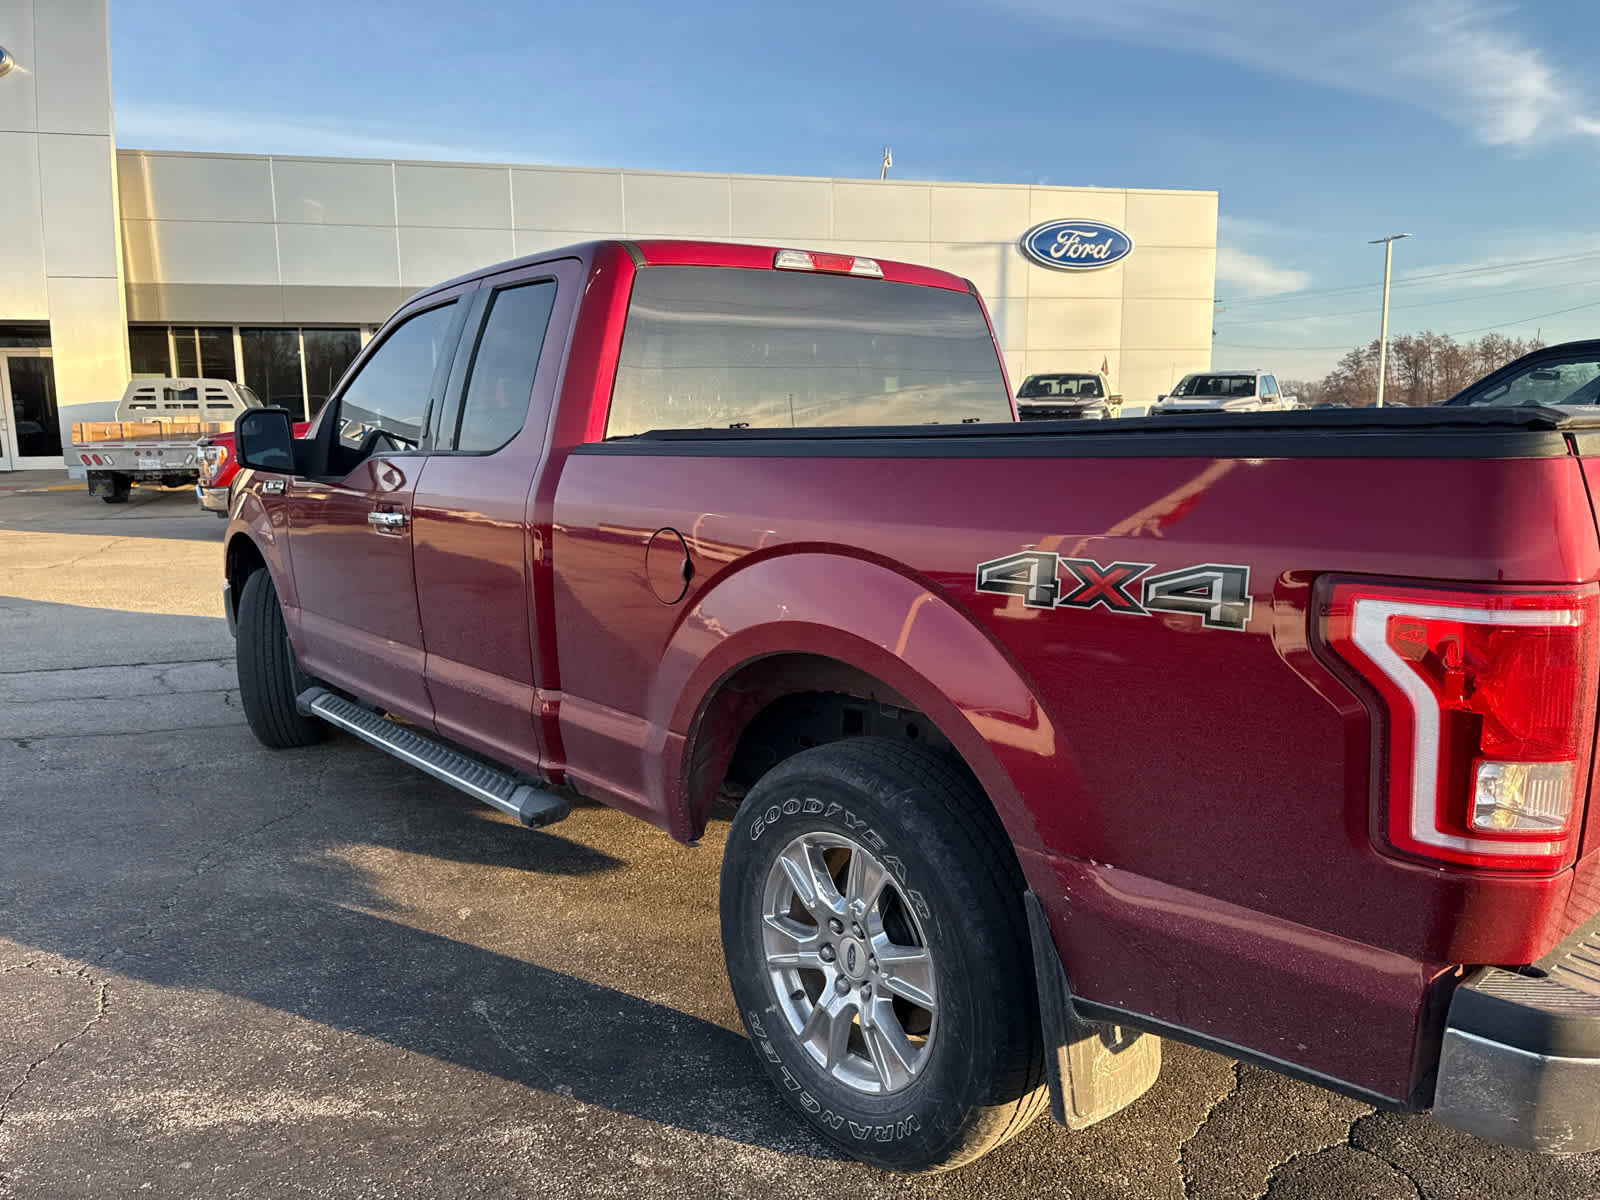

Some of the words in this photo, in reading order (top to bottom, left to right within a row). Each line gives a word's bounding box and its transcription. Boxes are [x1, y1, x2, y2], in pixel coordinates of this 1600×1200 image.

[1050, 229, 1113, 258] Ford
[750, 798, 930, 920] GOODYEAR
[750, 1011, 921, 1143] WRANGLER
